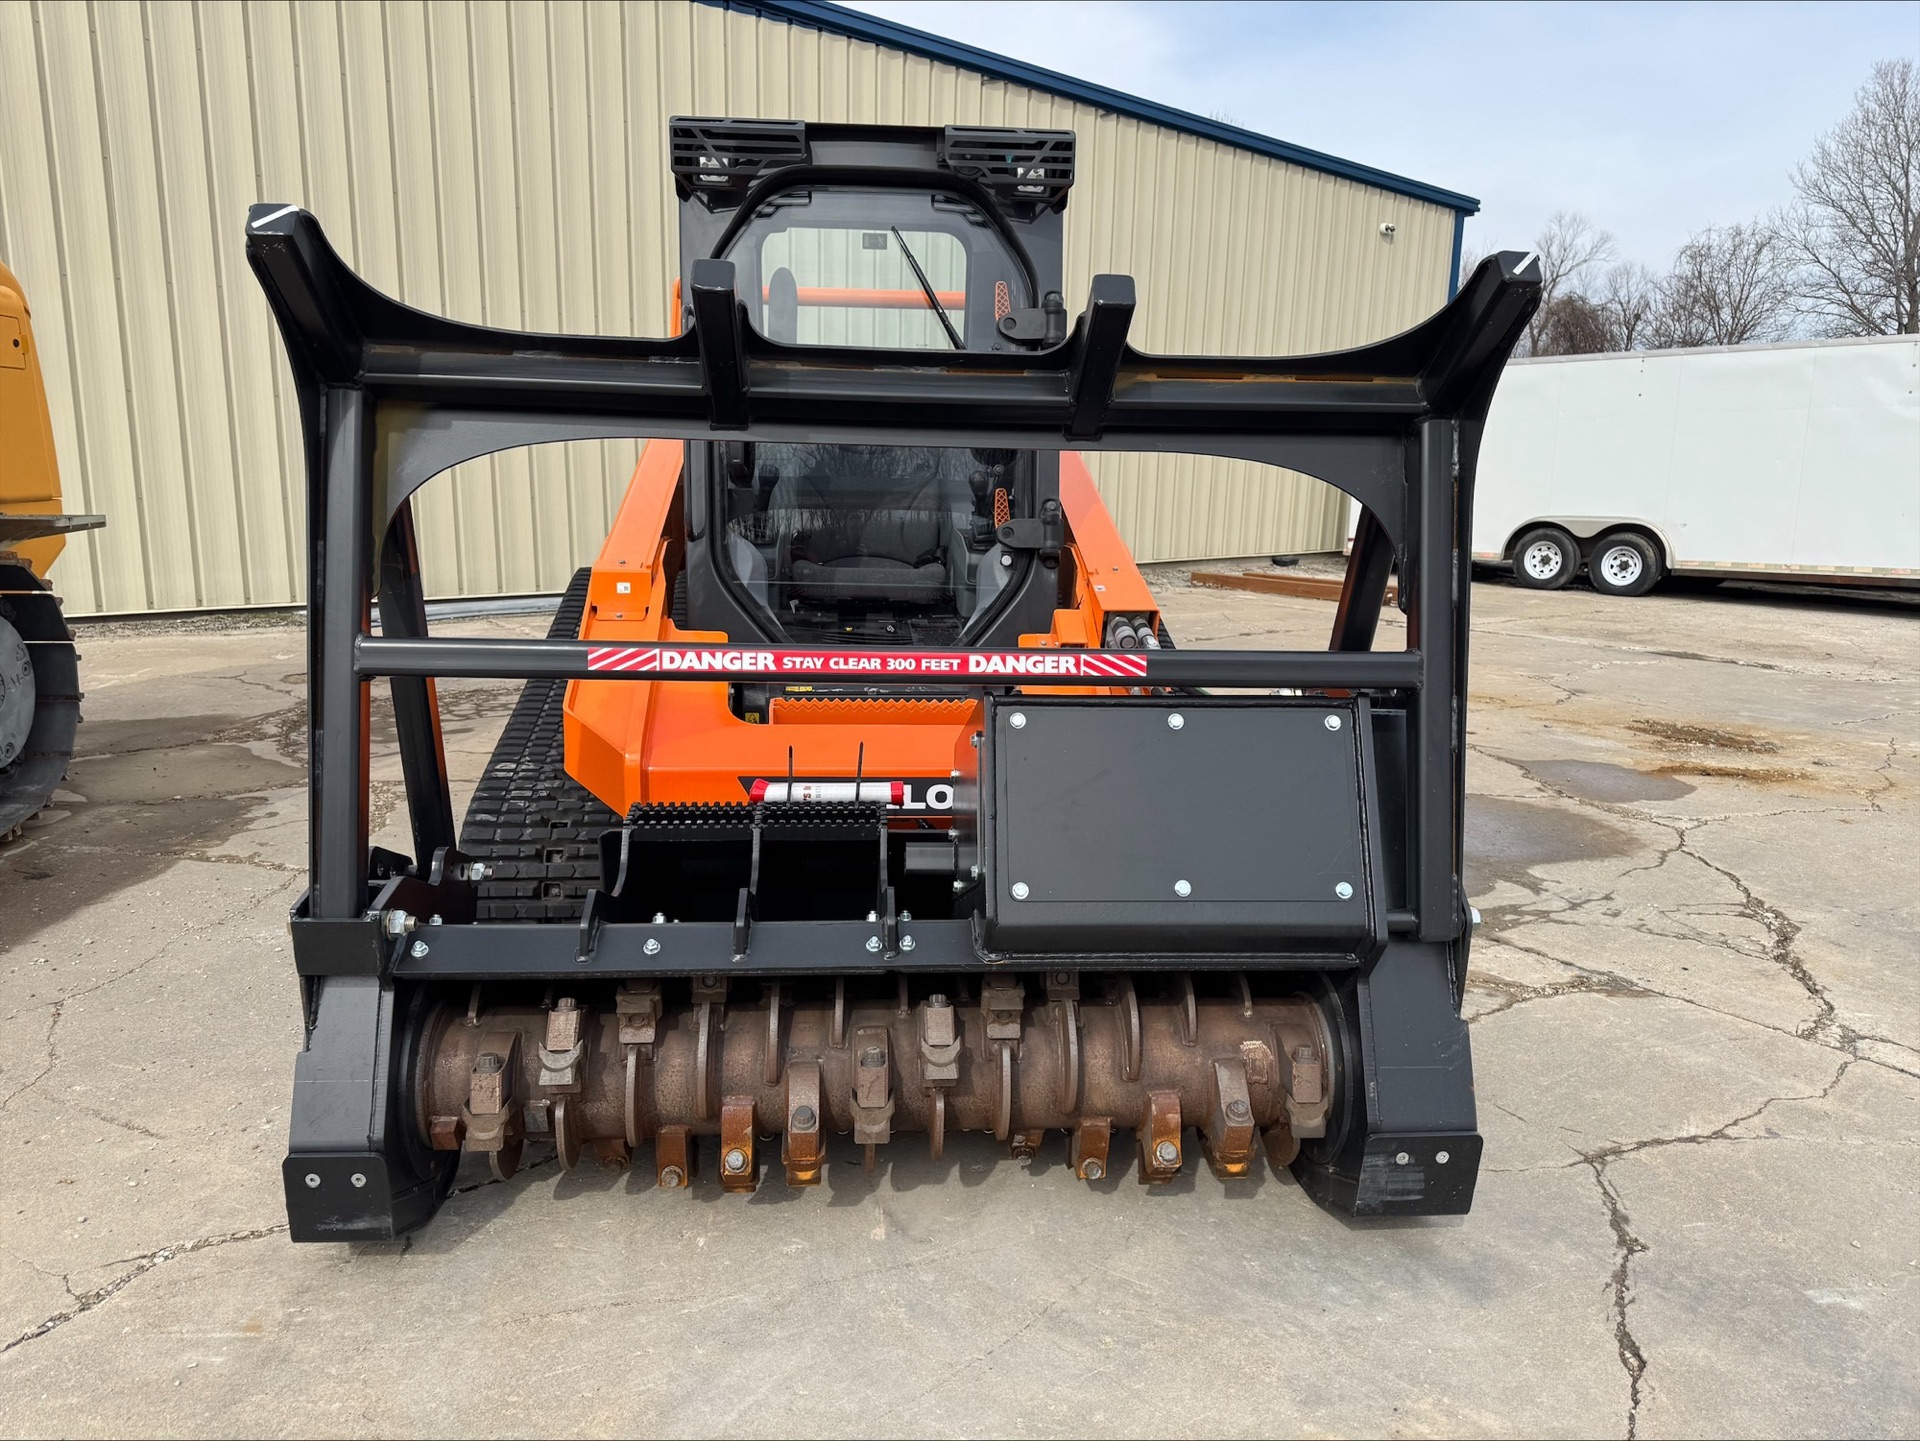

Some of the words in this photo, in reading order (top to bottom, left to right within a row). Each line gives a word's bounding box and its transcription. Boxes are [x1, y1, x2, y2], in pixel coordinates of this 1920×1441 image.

[662, 651, 777, 670] DANGER
[782, 657, 825, 669] STAY
[829, 658, 881, 669] CLEAR
[886, 659, 916, 670] 300
[921, 659, 961, 670] FEET
[969, 655, 1077, 673] DANGER
[886, 784, 954, 810] LO
